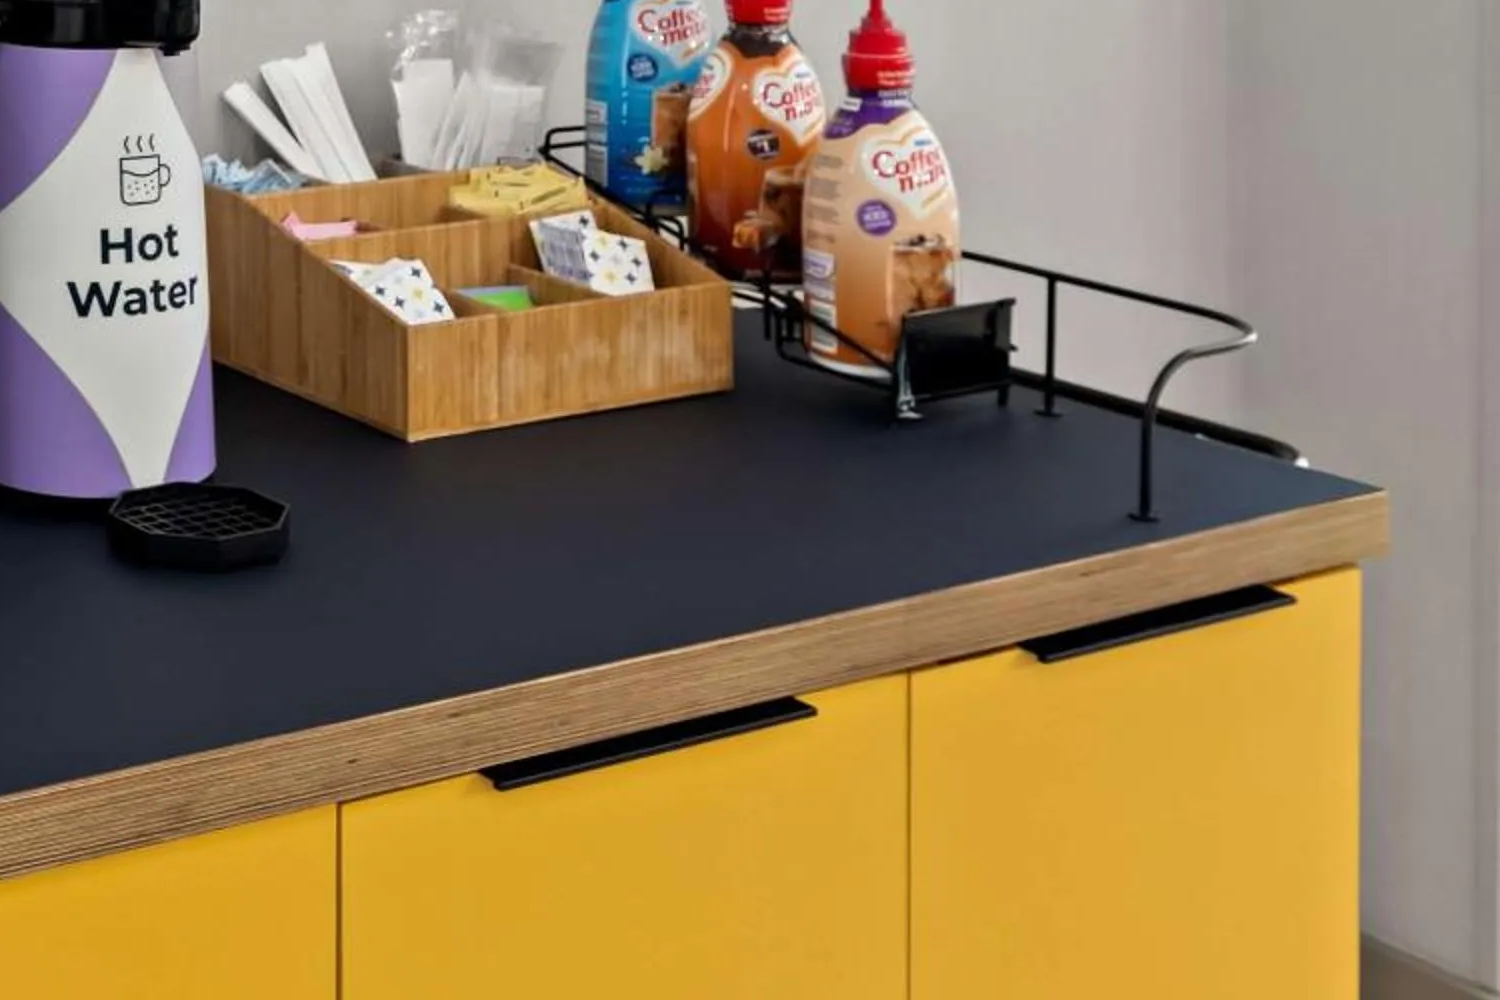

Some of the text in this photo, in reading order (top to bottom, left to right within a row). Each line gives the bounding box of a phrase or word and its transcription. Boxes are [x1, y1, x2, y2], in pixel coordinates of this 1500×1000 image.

[661, 20, 708, 46] mat
[100, 224, 179, 265] Hot
[66, 276, 198, 318] Water
